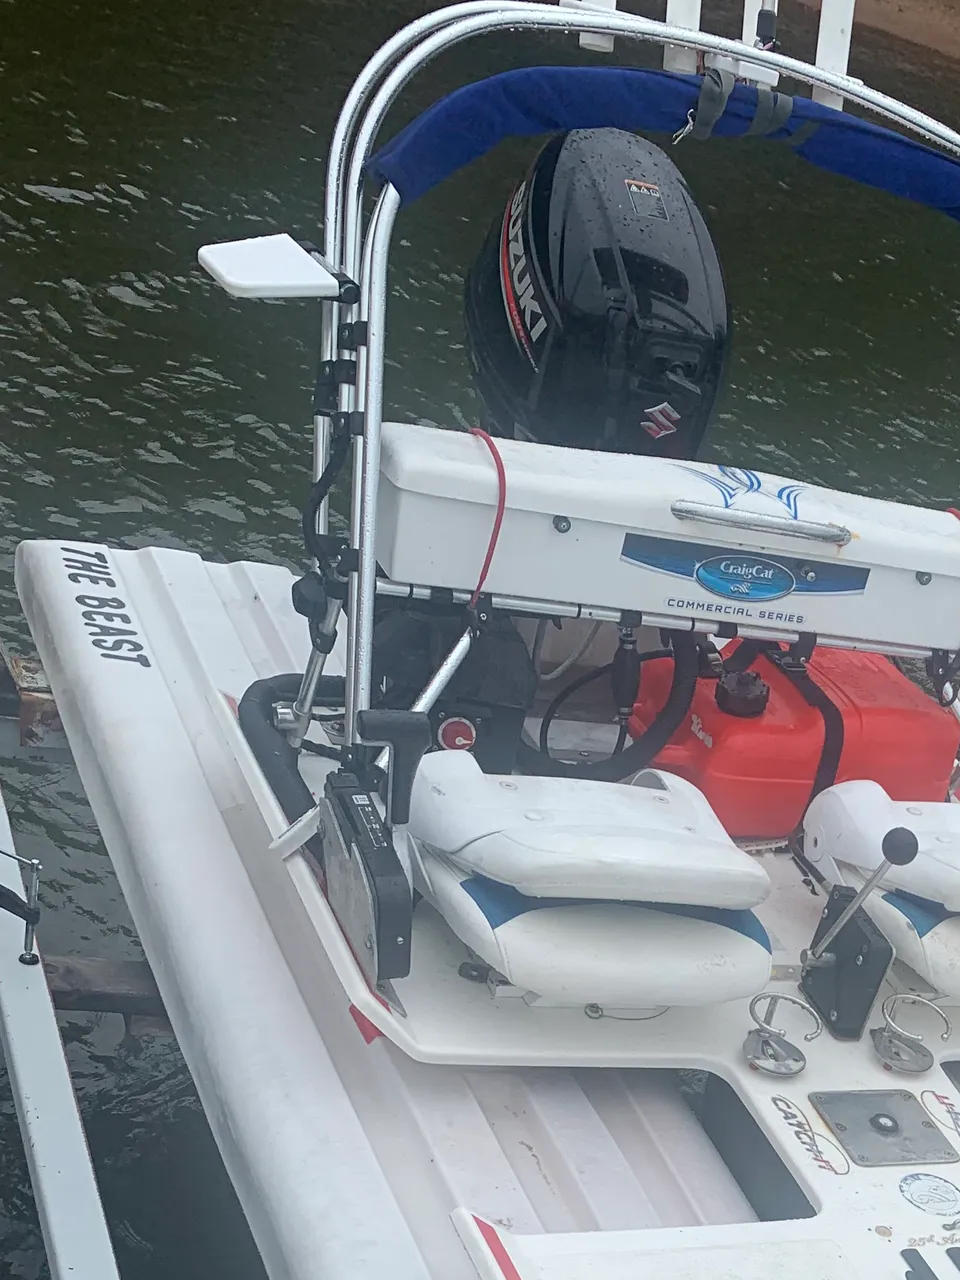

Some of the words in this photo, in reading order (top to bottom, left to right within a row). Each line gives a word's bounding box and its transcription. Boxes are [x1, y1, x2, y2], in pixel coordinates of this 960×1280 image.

[508, 182, 548, 343] SUZUKI
[60, 546, 117, 588] THE
[720, 560, 775, 580] CraigCat
[75, 594, 152, 668] BEAST
[667, 598, 753, 618] COMMERCIAL
[758, 610, 804, 624] SERIES
